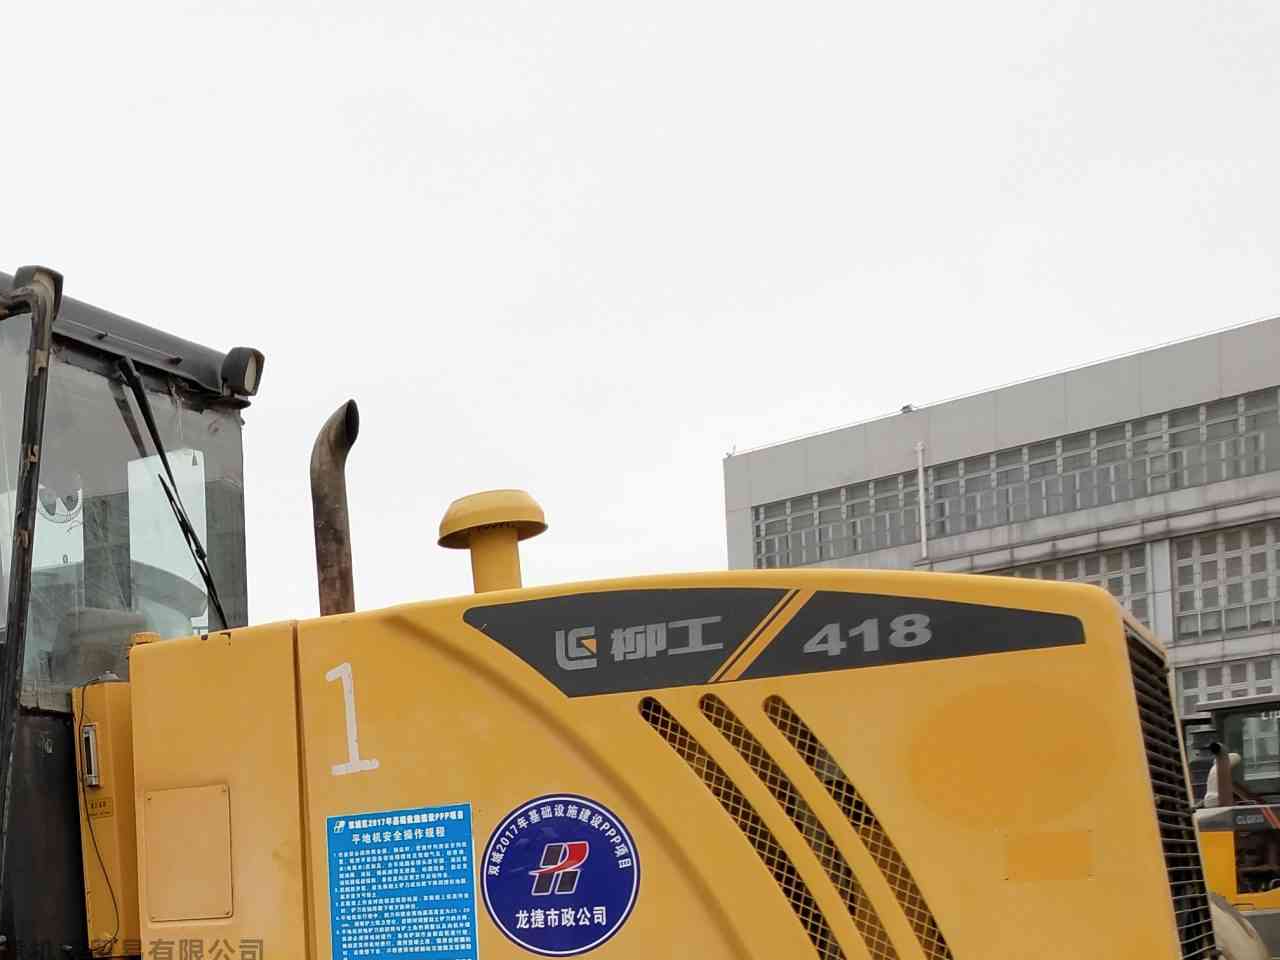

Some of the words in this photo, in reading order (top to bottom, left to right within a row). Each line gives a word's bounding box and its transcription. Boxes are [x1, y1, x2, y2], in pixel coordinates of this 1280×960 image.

[610, 615, 723, 662] 柳工
[803, 613, 932, 657] 418
[325, 662, 381, 776] 1
[515, 906, 607, 929] 龙捷市政公司
